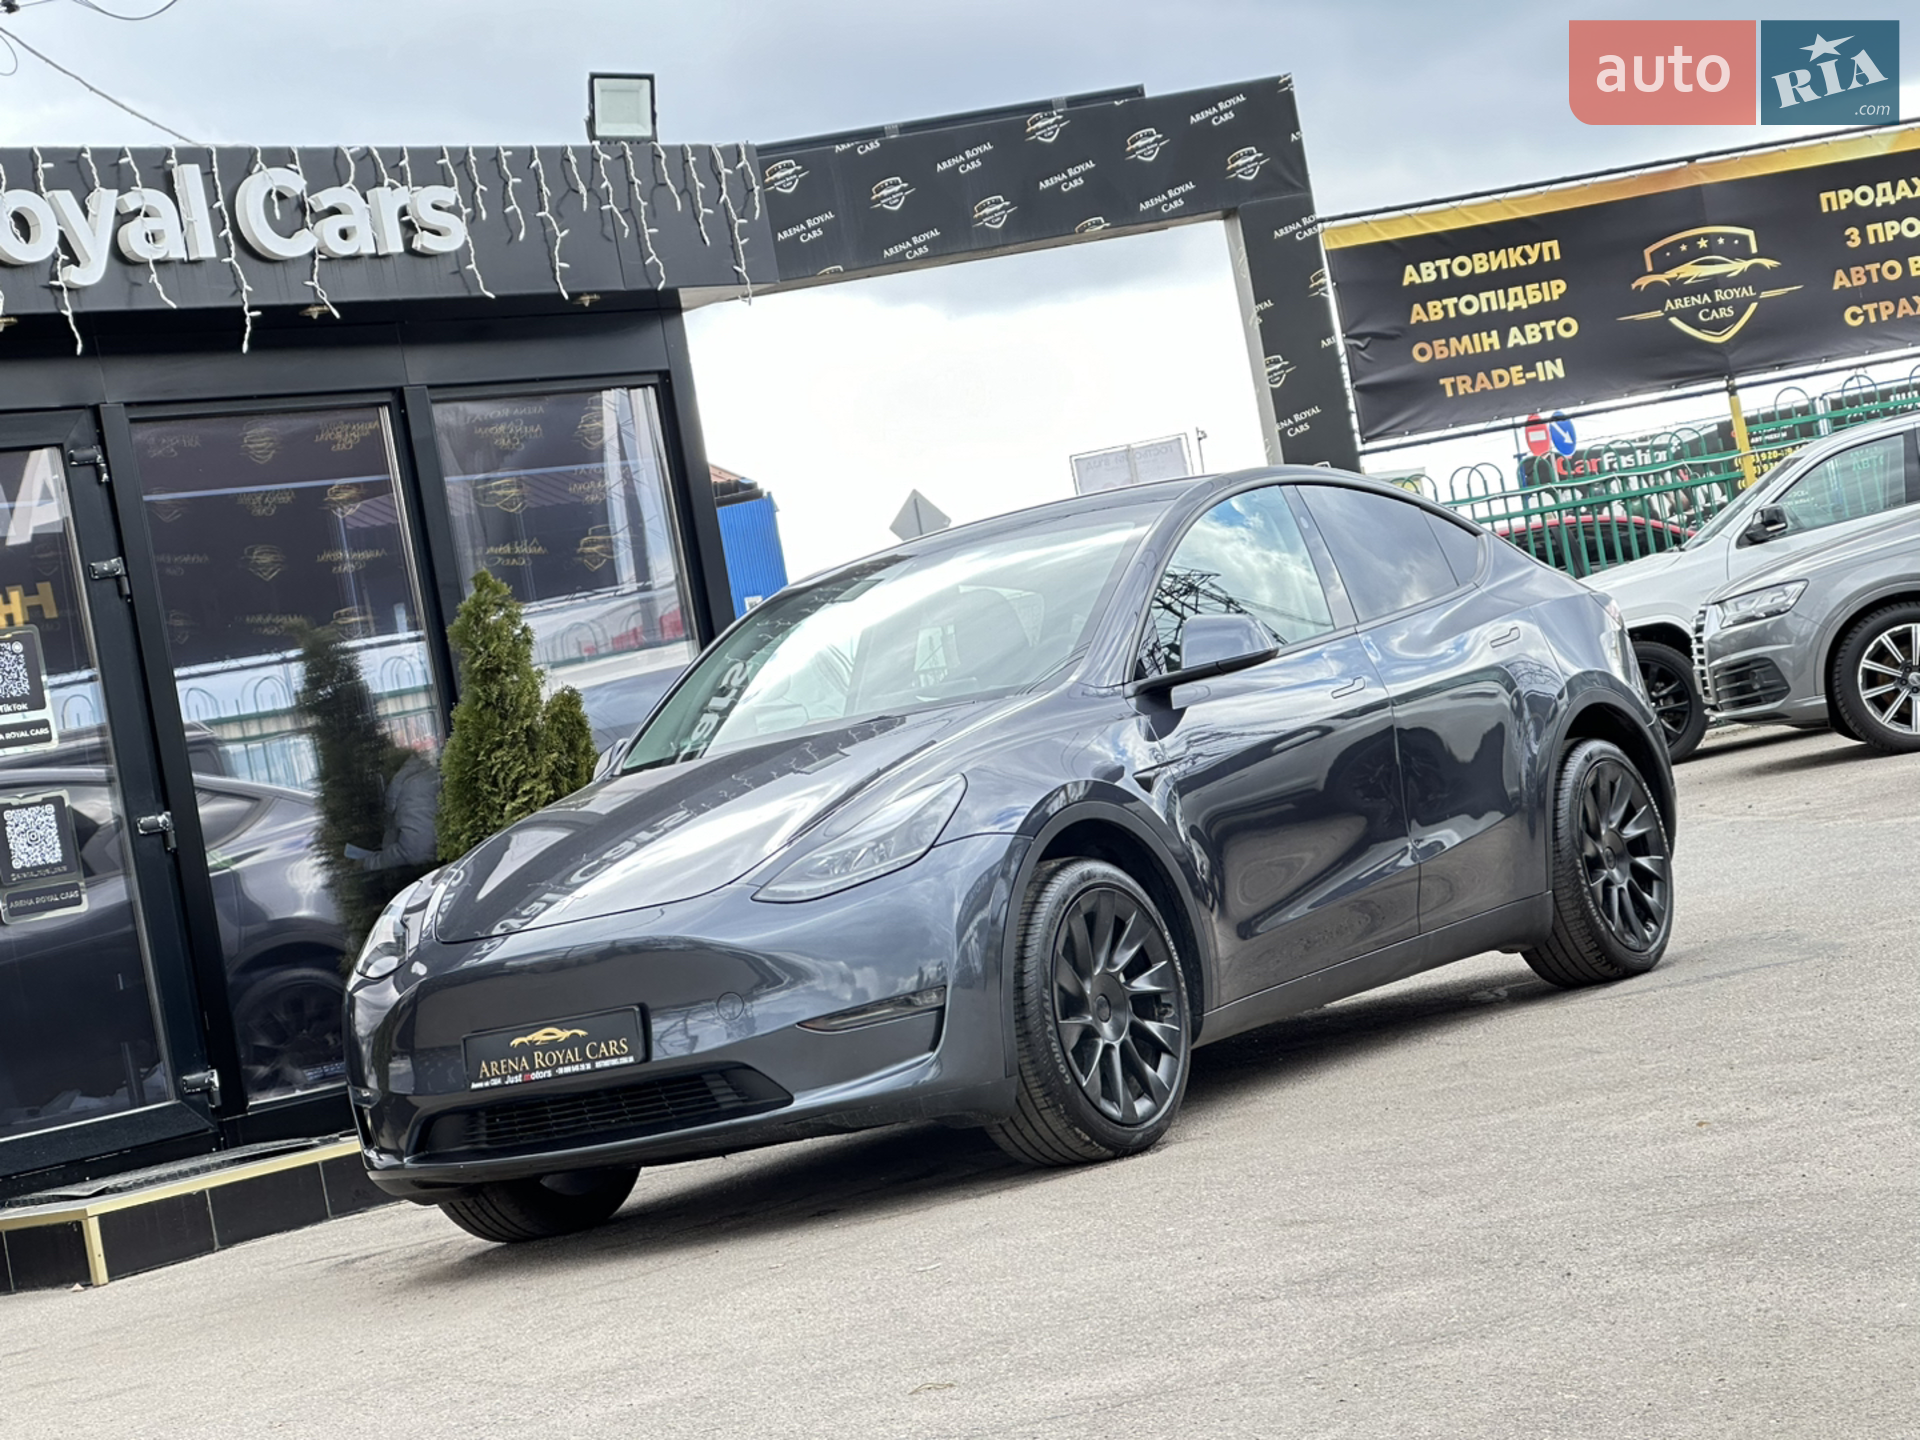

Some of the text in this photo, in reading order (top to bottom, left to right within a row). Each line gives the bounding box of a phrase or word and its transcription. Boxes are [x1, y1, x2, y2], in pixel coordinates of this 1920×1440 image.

[235, 167, 467, 260] Cars
[1402, 239, 1561, 286] АВТОВИКУП
[1832, 259, 1903, 290] АВТО
[1409, 279, 1568, 325] АВТОПІДБІР
[1664, 285, 1757, 312] ARENA ROYAL
[1698, 305, 1735, 322] CARS
[1411, 316, 1580, 363] ОБМІН АВТО
[1439, 357, 1566, 398] TRADE-IN
[479, 1055, 530, 1079] ARENA
[533, 1046, 583, 1069] ROYAL
[585, 1037, 629, 1060] CARS
